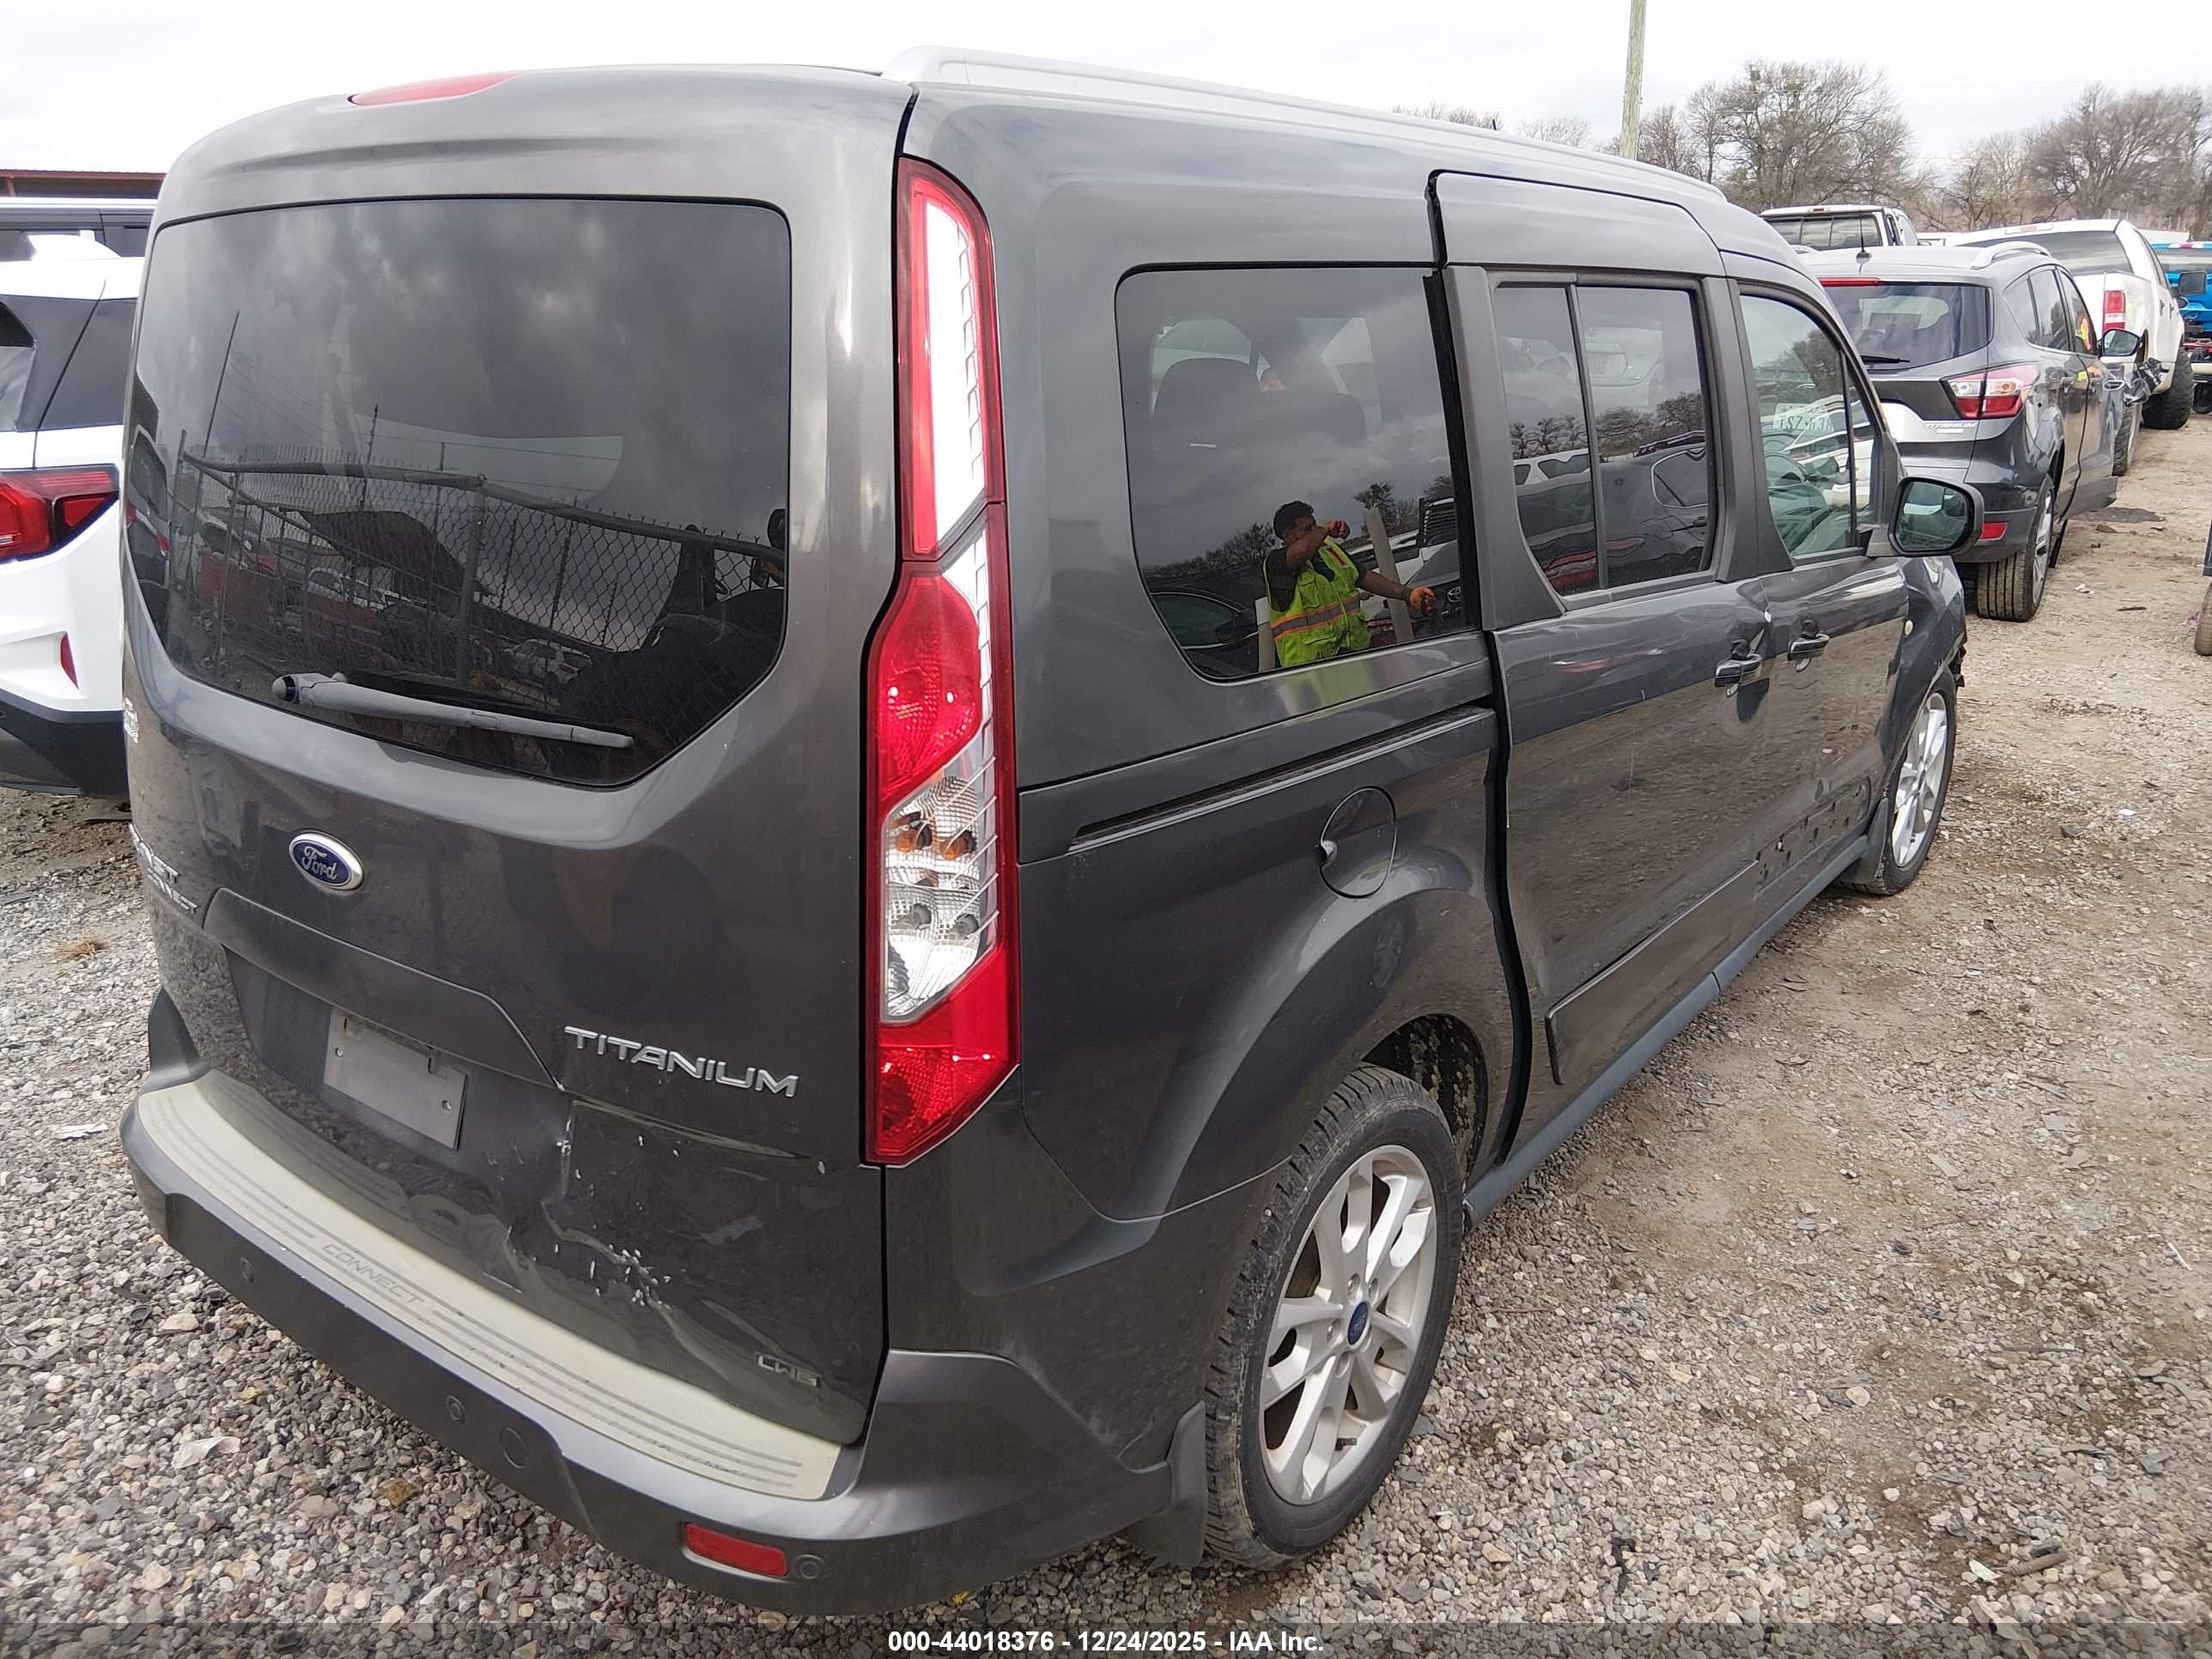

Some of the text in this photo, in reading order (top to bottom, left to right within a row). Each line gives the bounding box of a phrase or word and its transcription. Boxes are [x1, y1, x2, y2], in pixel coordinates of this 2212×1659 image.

[301, 846, 337, 880] Ford
[564, 1025, 799, 1097] TITANIUM
[321, 1243, 425, 1304] CONNECT
